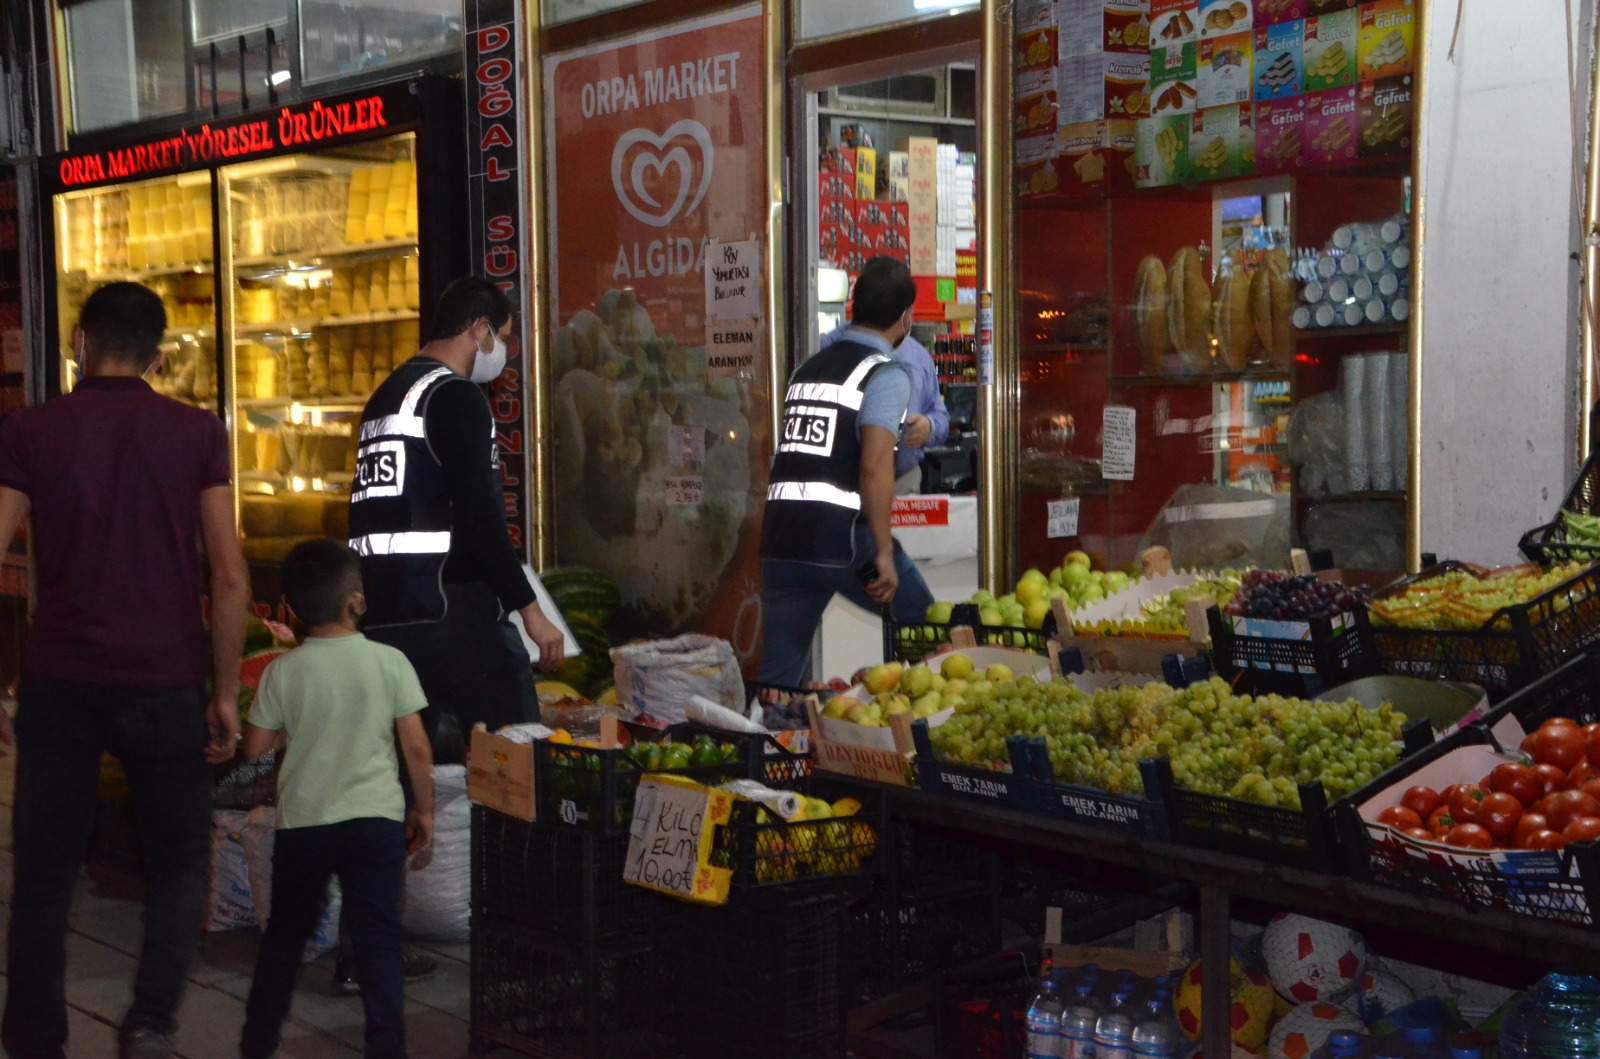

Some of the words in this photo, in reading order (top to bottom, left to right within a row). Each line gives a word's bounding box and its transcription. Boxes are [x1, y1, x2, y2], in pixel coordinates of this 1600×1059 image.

[1375, 13, 1411, 29] Gofret
[1267, 37, 1300, 52] Gofret
[581, 74, 639, 119] ORPA
[645, 52, 740, 106] MARKET
[476, 25, 513, 182] DOĞAL
[1374, 91, 1411, 107] Gofret
[1321, 101, 1355, 116] Gofret
[1271, 112, 1304, 126] Gofret
[60, 153, 106, 186] ORPA
[108, 137, 184, 178] MARKET
[187, 124, 274, 162] YÖRESEL
[278, 96, 387, 147] ÜRÜNLER
[713, 332, 753, 344] ELEMAN
[708, 355, 754, 368] ARANIYOR
[911, 499, 940, 511] MESAFE
[940, 772, 971, 786] EMEK
[973, 778, 1008, 795] TARIM
[952, 783, 999, 799] BULANIK
[1062, 794, 1096, 811] EMEK
[1098, 801, 1139, 820] TARIM
[1075, 807, 1128, 824] BULANIK
